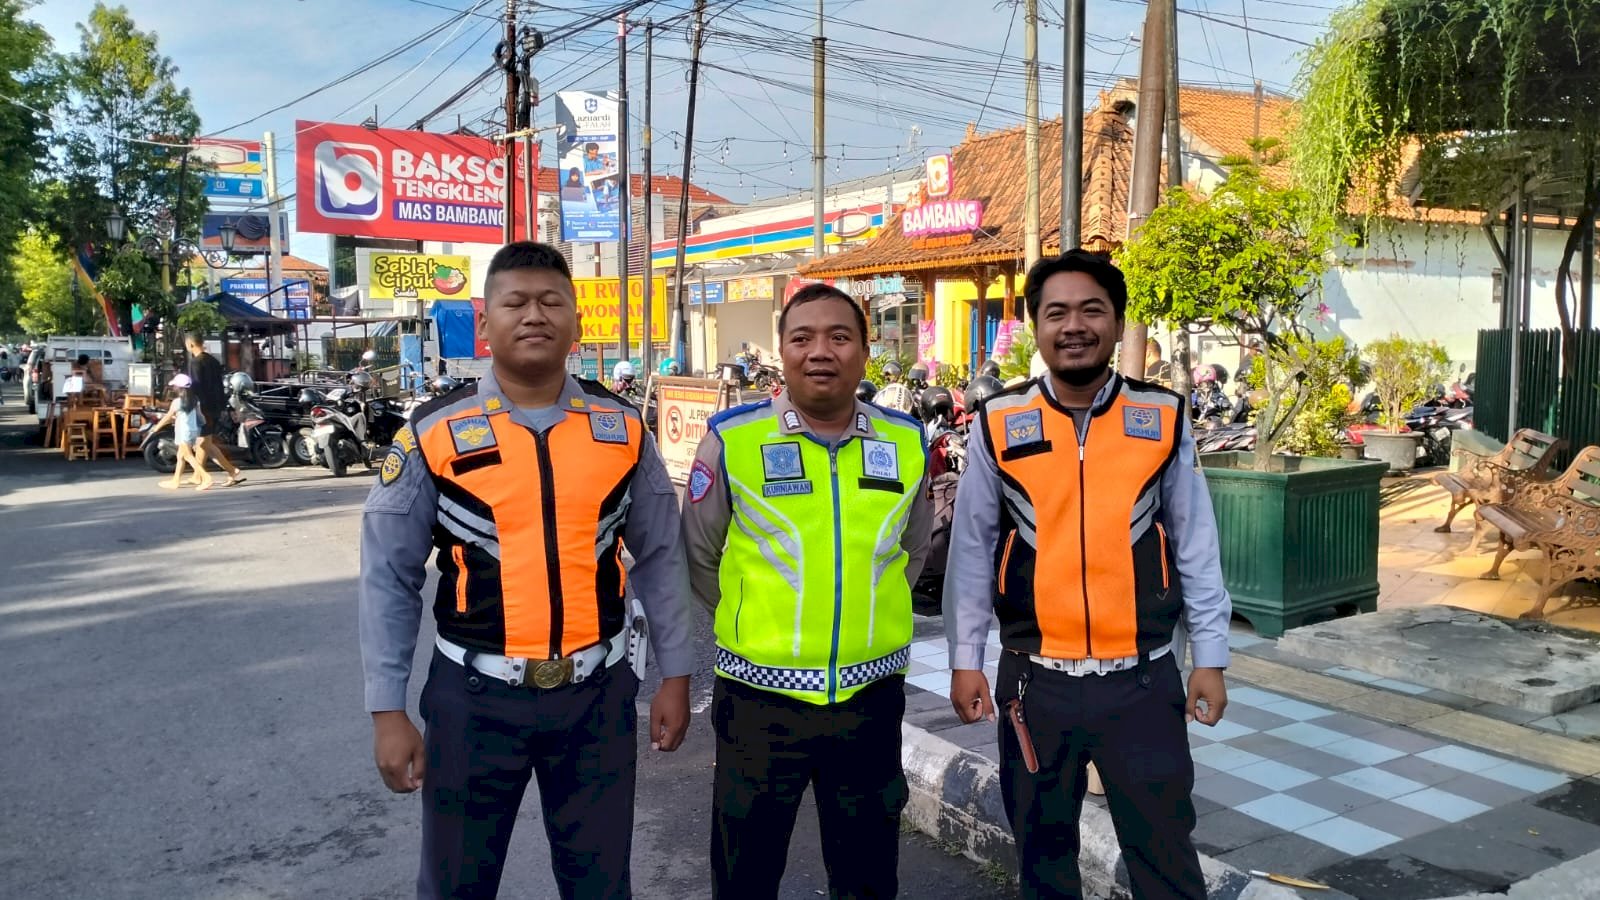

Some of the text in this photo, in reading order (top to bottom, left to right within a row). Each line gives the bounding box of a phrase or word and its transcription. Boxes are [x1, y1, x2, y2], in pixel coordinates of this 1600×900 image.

[392, 149, 505, 186] BAKSO
[399, 202, 431, 221] MAS
[902, 201, 977, 232] BAMBANG
[375, 256, 438, 275] Seblak
[379, 271, 436, 292] Cipuk
[454, 418, 488, 432] DISHUB
[1126, 427, 1159, 438] DISHUB
[595, 432, 625, 441] DISHUB
[766, 483, 810, 495] KURNIAWAN
